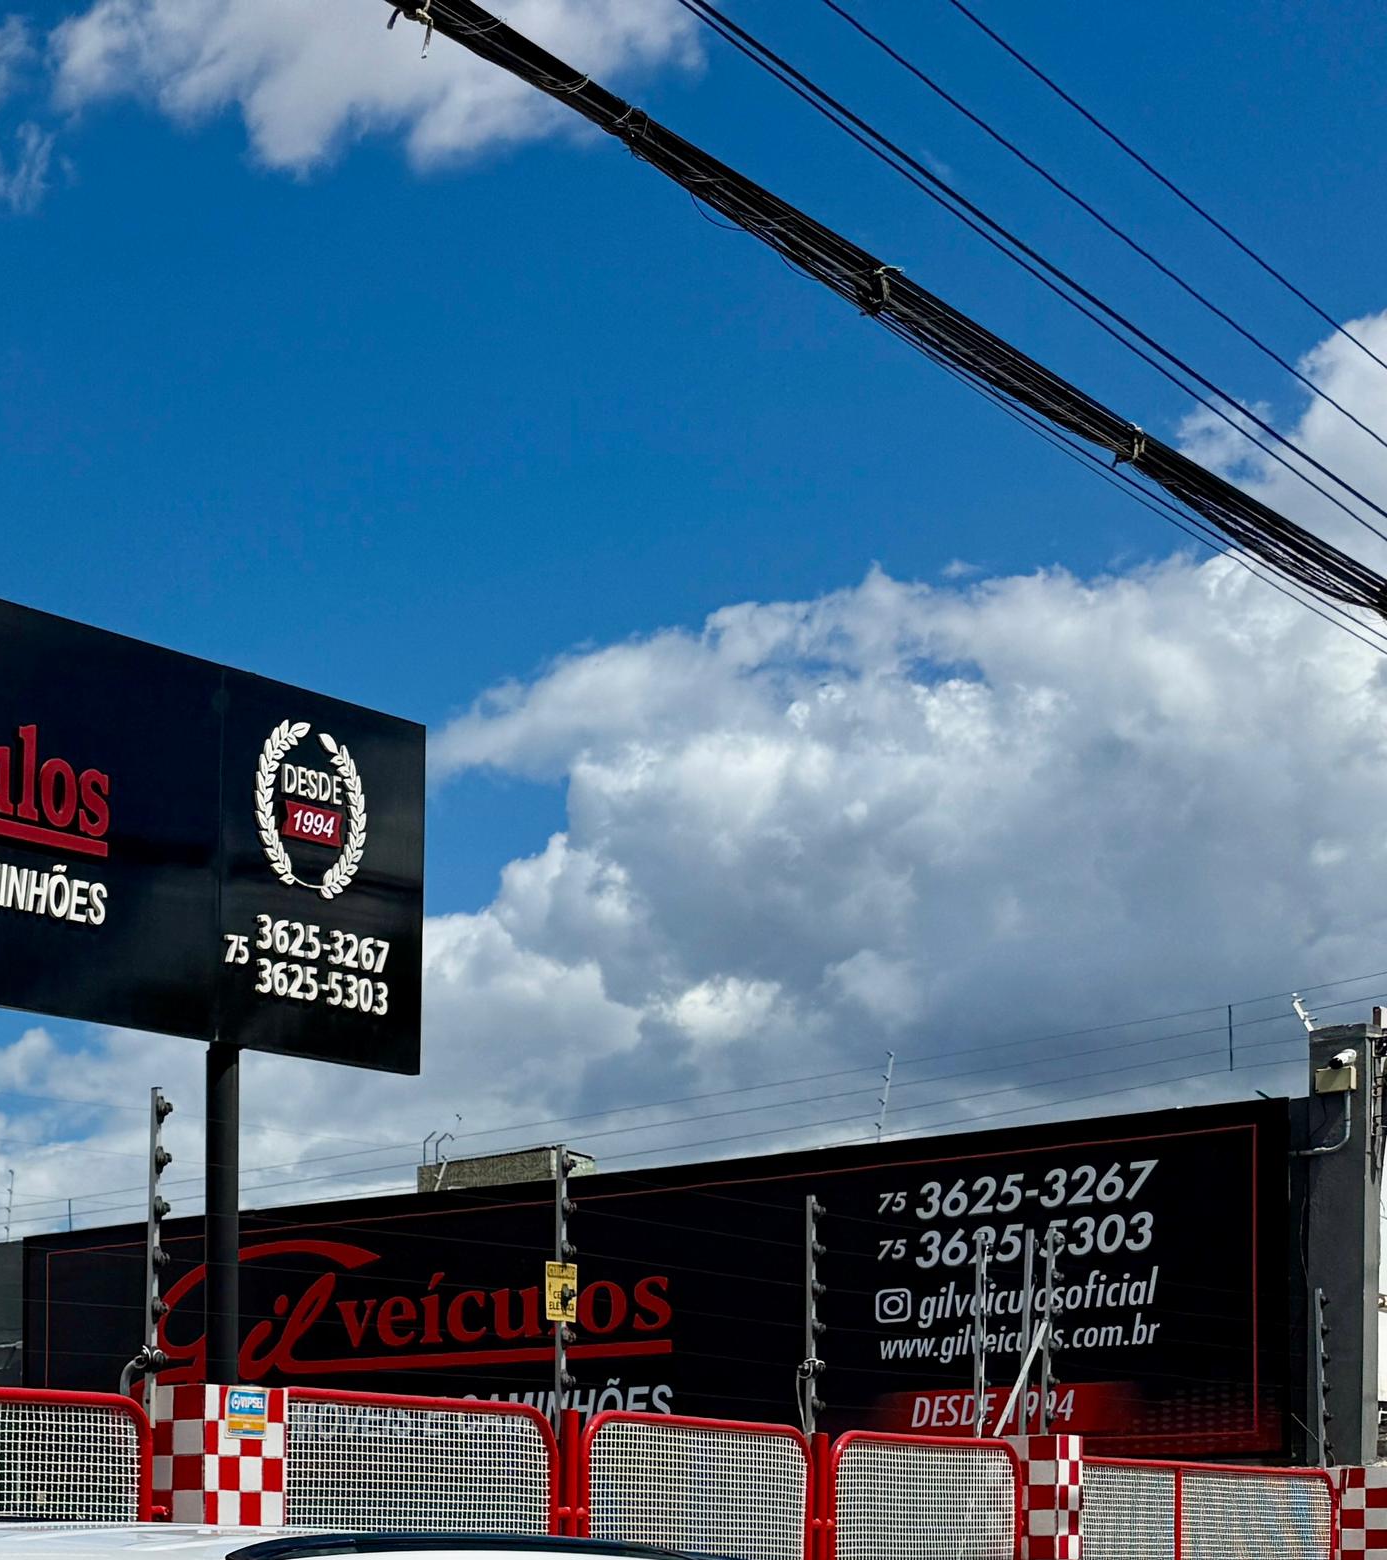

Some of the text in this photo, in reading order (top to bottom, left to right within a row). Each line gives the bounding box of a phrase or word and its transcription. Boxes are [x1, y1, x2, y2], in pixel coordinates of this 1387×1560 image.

[282, 763, 343, 805] DESDE
[293, 809, 335, 839] 1994
[224, 914, 390, 973] 75 3625-3267
[255, 958, 389, 1016] 3625-5303
[878, 1159, 1159, 1219] 75 3625-3267
[878, 1239, 908, 1260] 75
[336, 1272, 673, 1347] veícuos
